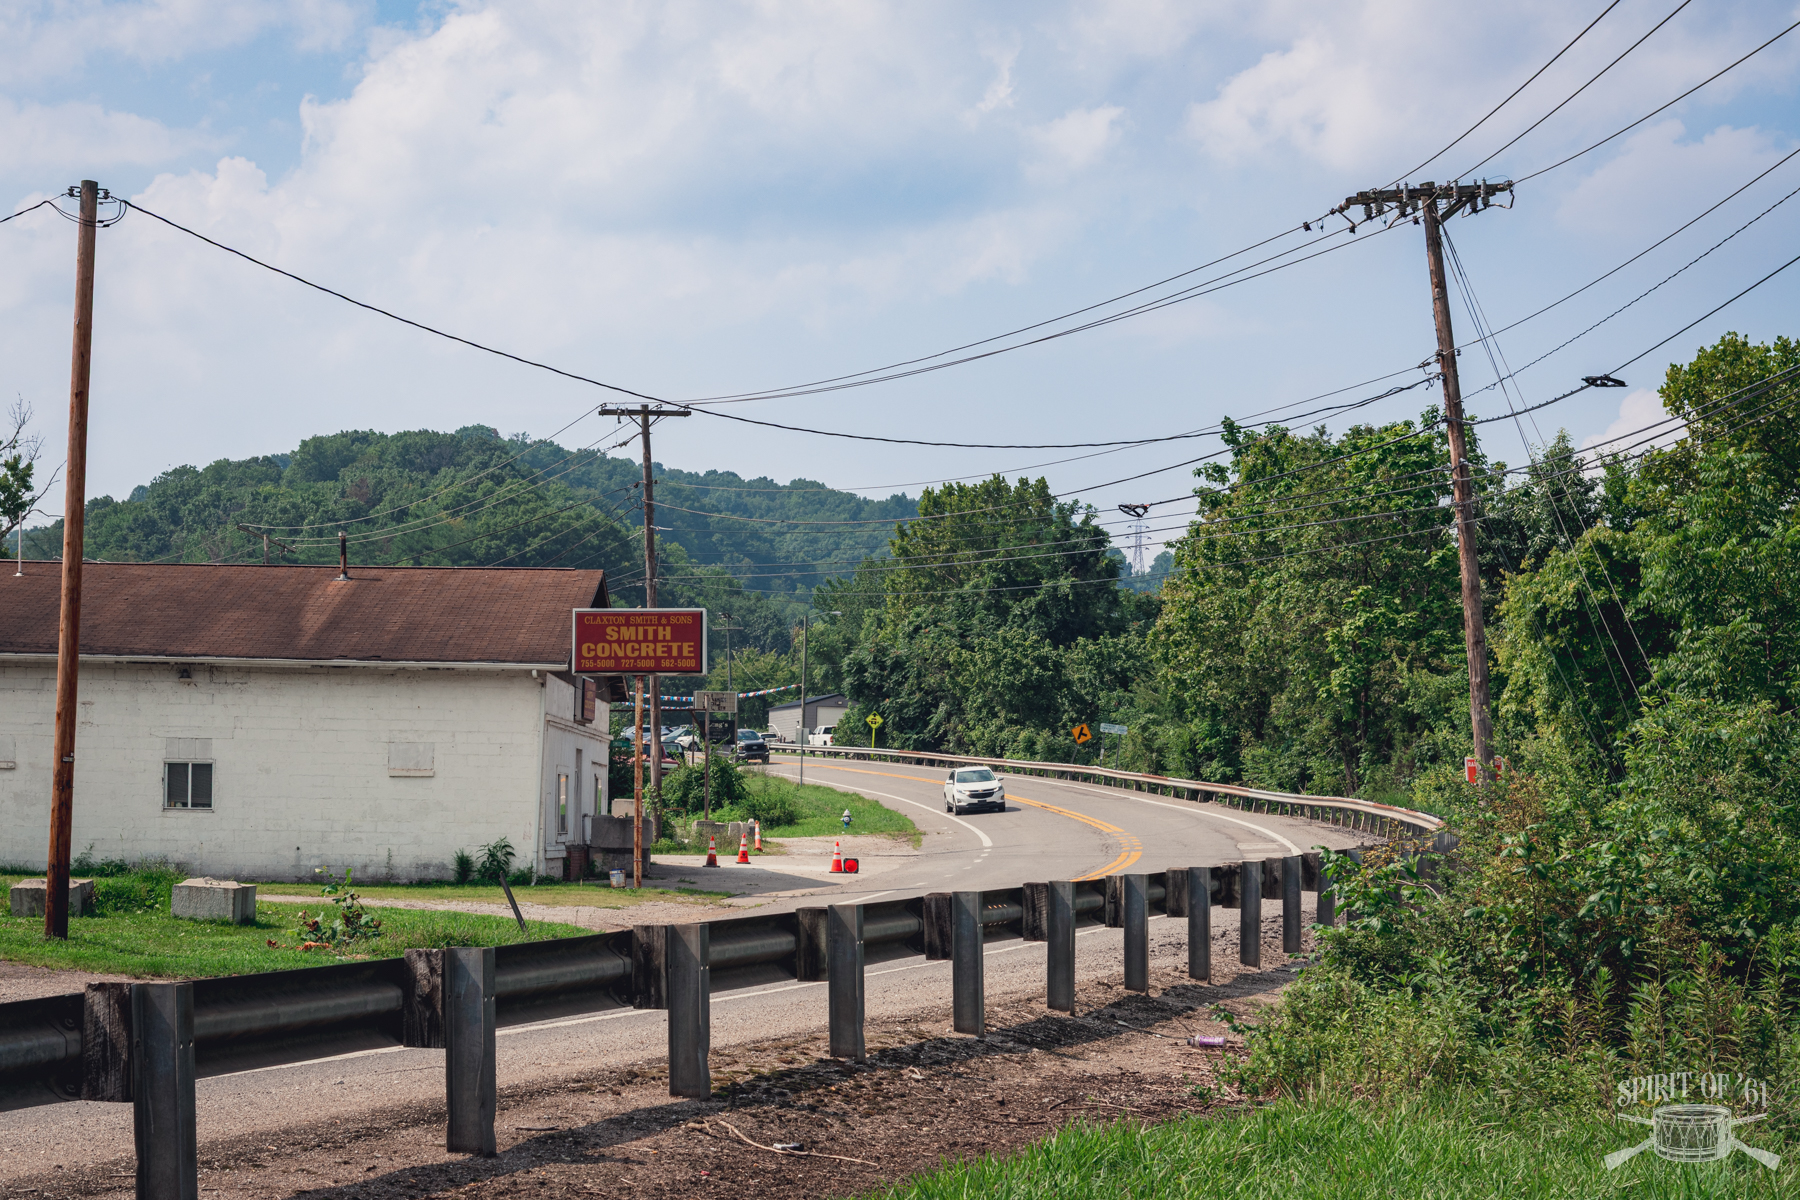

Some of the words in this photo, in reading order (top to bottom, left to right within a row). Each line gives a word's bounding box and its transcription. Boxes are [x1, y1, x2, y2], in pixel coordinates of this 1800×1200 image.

[584, 616, 626, 625] CLAXTON
[629, 616, 658, 625] SMITH
[660, 616, 668, 624] &
[669, 616, 693, 625] SONS
[605, 626, 672, 641] SMITH
[581, 642, 695, 658] CONCRETE
[580, 659, 615, 668] 755-5000
[620, 659, 655, 668] 727-5000
[661, 658, 696, 668] 562-5000
